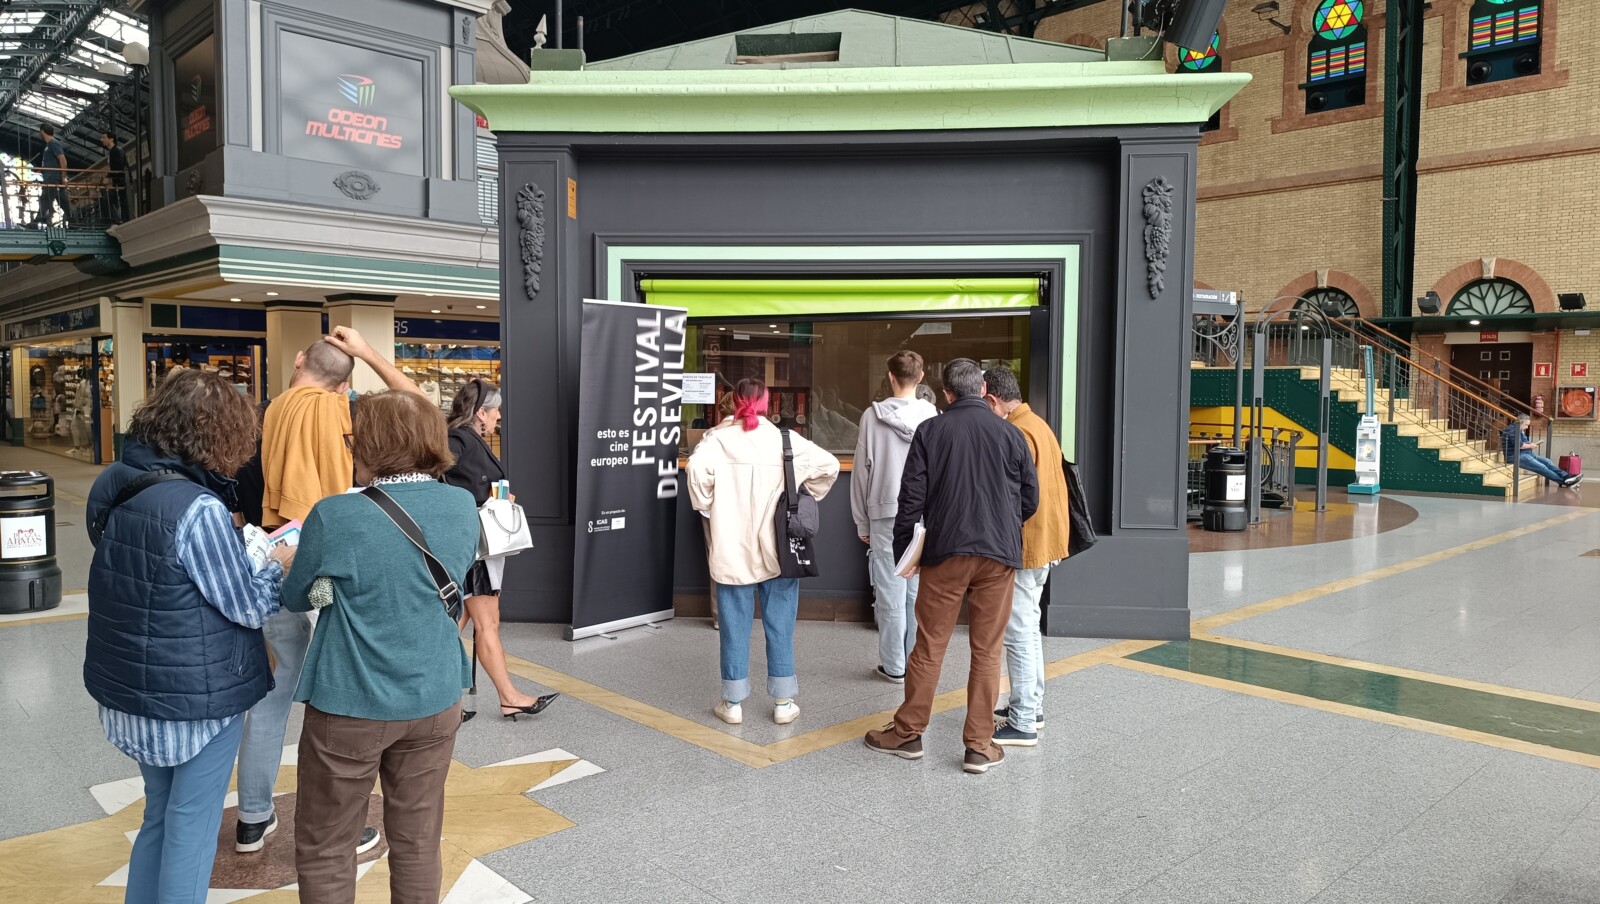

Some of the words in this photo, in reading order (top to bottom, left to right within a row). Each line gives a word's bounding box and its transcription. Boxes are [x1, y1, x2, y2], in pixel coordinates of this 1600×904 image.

[328, 108, 388, 131] ODEON
[305, 120, 403, 149] MULTICINES
[631, 310, 661, 466] FESTIVAL
[660, 314, 687, 446] SEVILLA
[597, 429, 617, 439] esto
[619, 429, 630, 438] es
[610, 441, 629, 451] cine
[590, 456, 628, 467] europeo
[657, 458, 680, 499] DE
